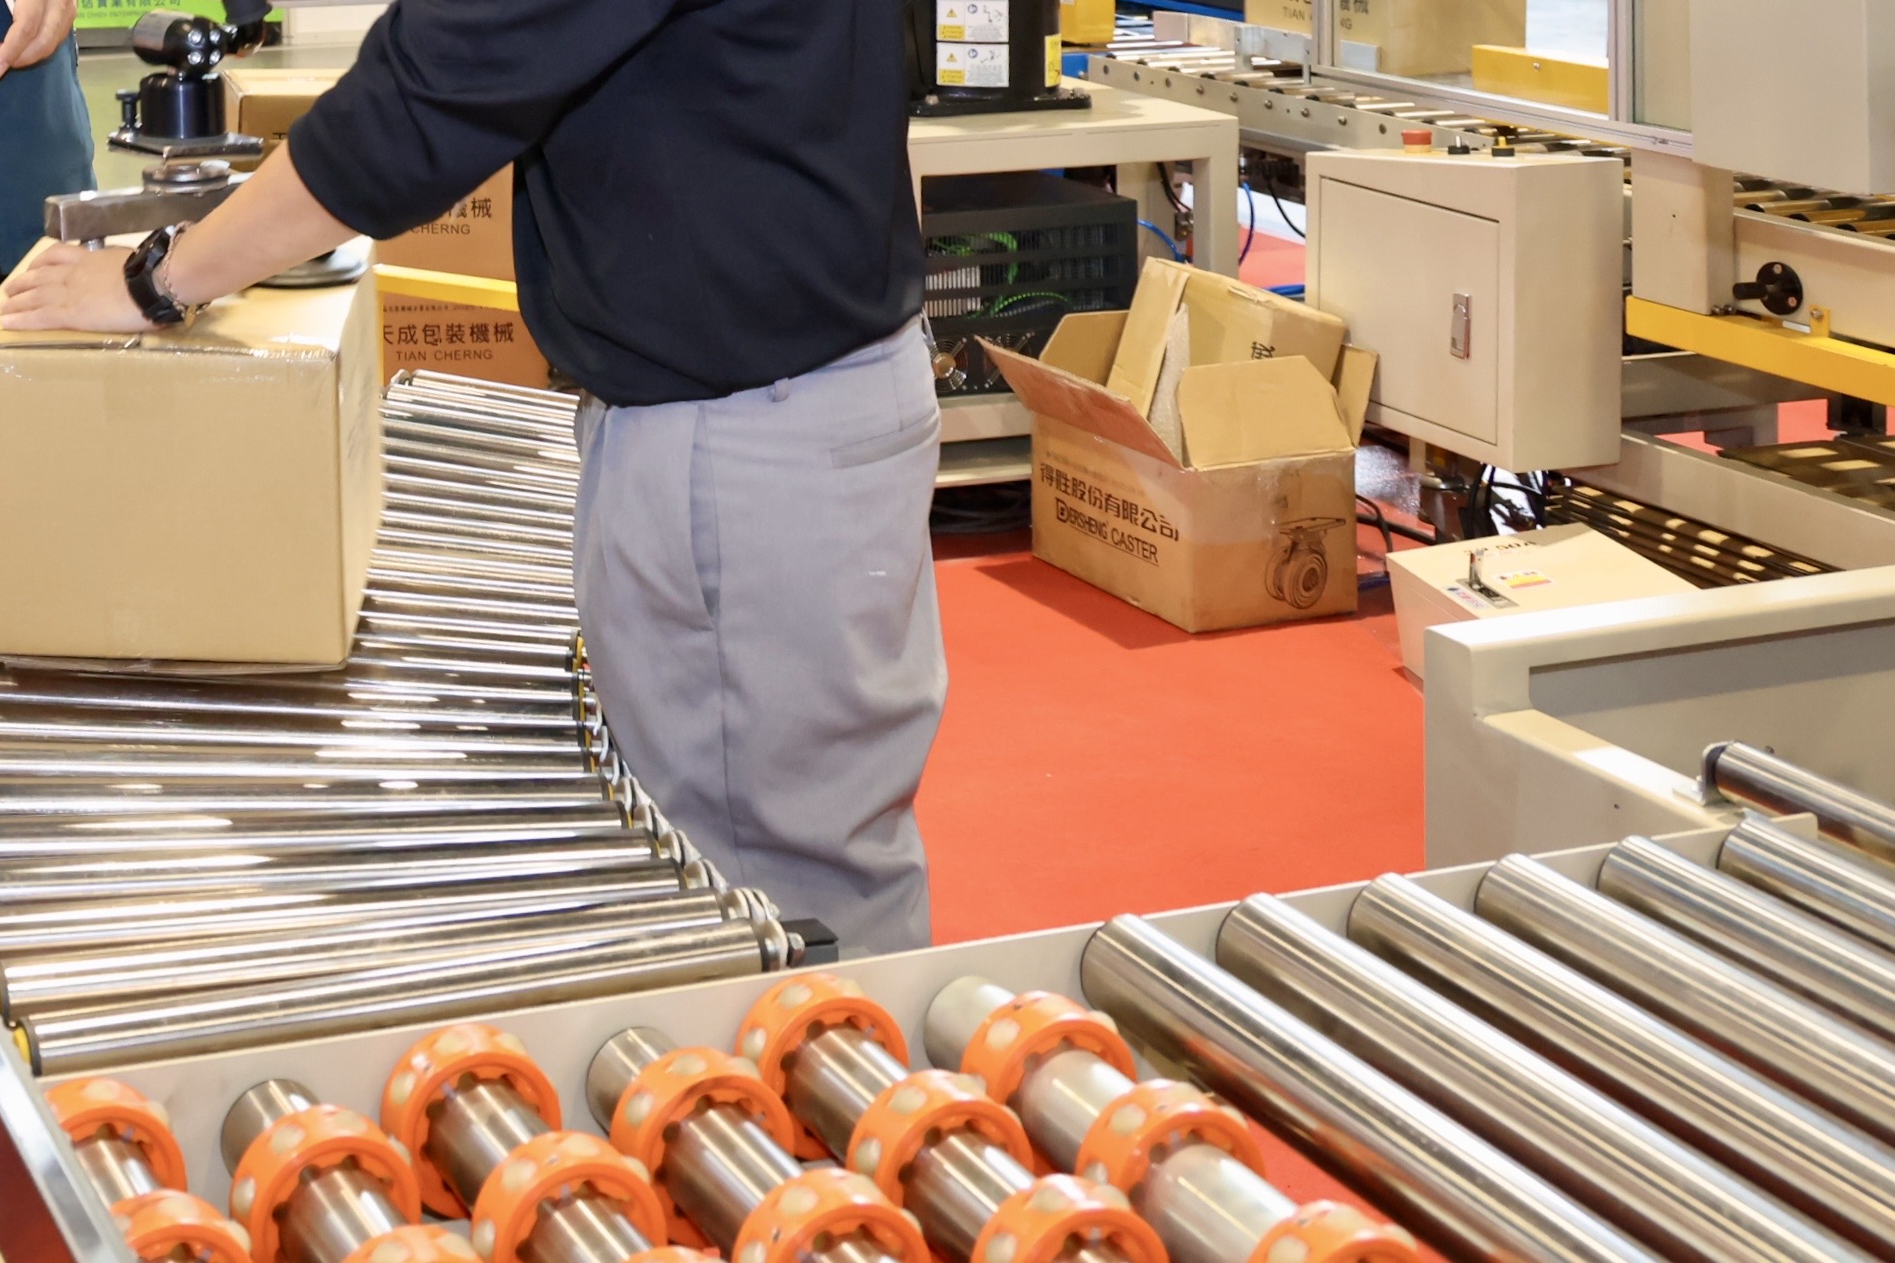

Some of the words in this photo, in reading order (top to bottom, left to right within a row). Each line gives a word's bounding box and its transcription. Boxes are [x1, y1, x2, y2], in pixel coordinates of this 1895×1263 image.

[396, 351, 427, 362] TIAN
[434, 349, 493, 361] CHERNG
[1111, 528, 1159, 564] CASTER
